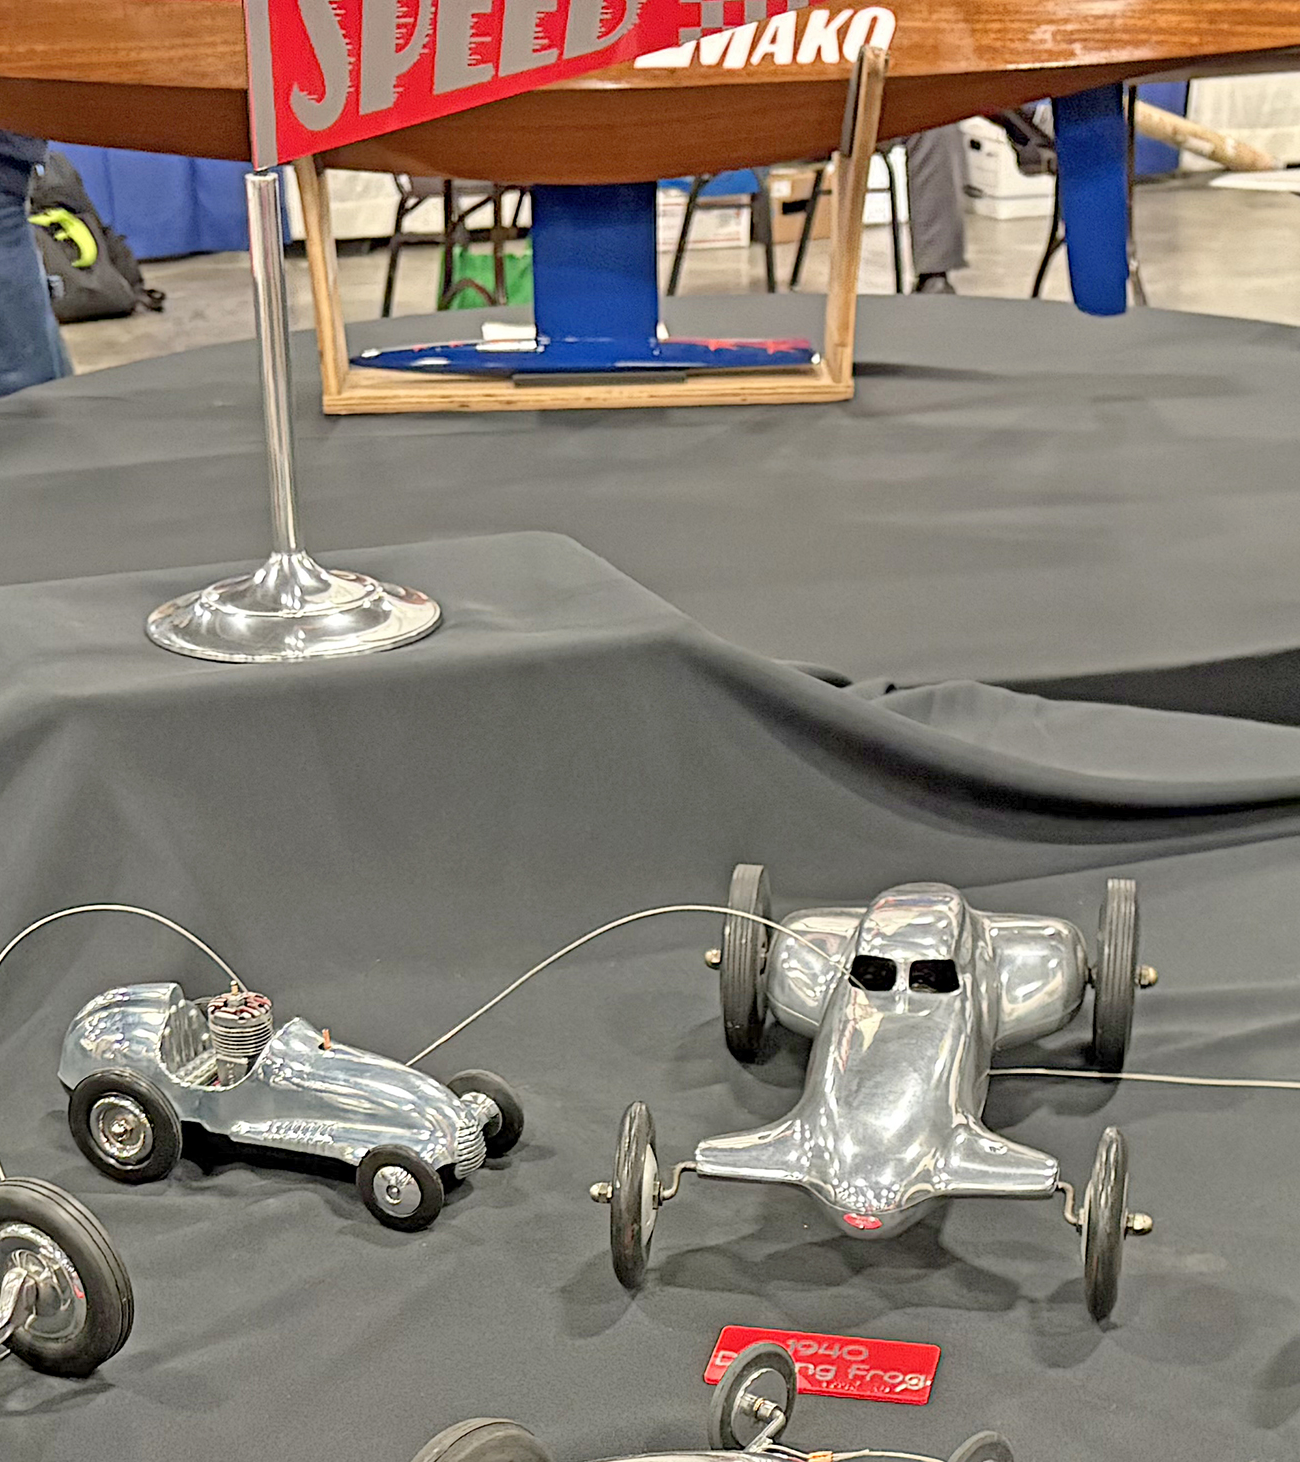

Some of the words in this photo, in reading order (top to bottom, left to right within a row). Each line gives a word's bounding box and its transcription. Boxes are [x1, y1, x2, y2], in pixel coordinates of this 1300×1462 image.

[290, 0, 645, 131] SPEED
[785, 1339, 869, 1362] 1940
[848, 1364, 927, 1391] Frog
